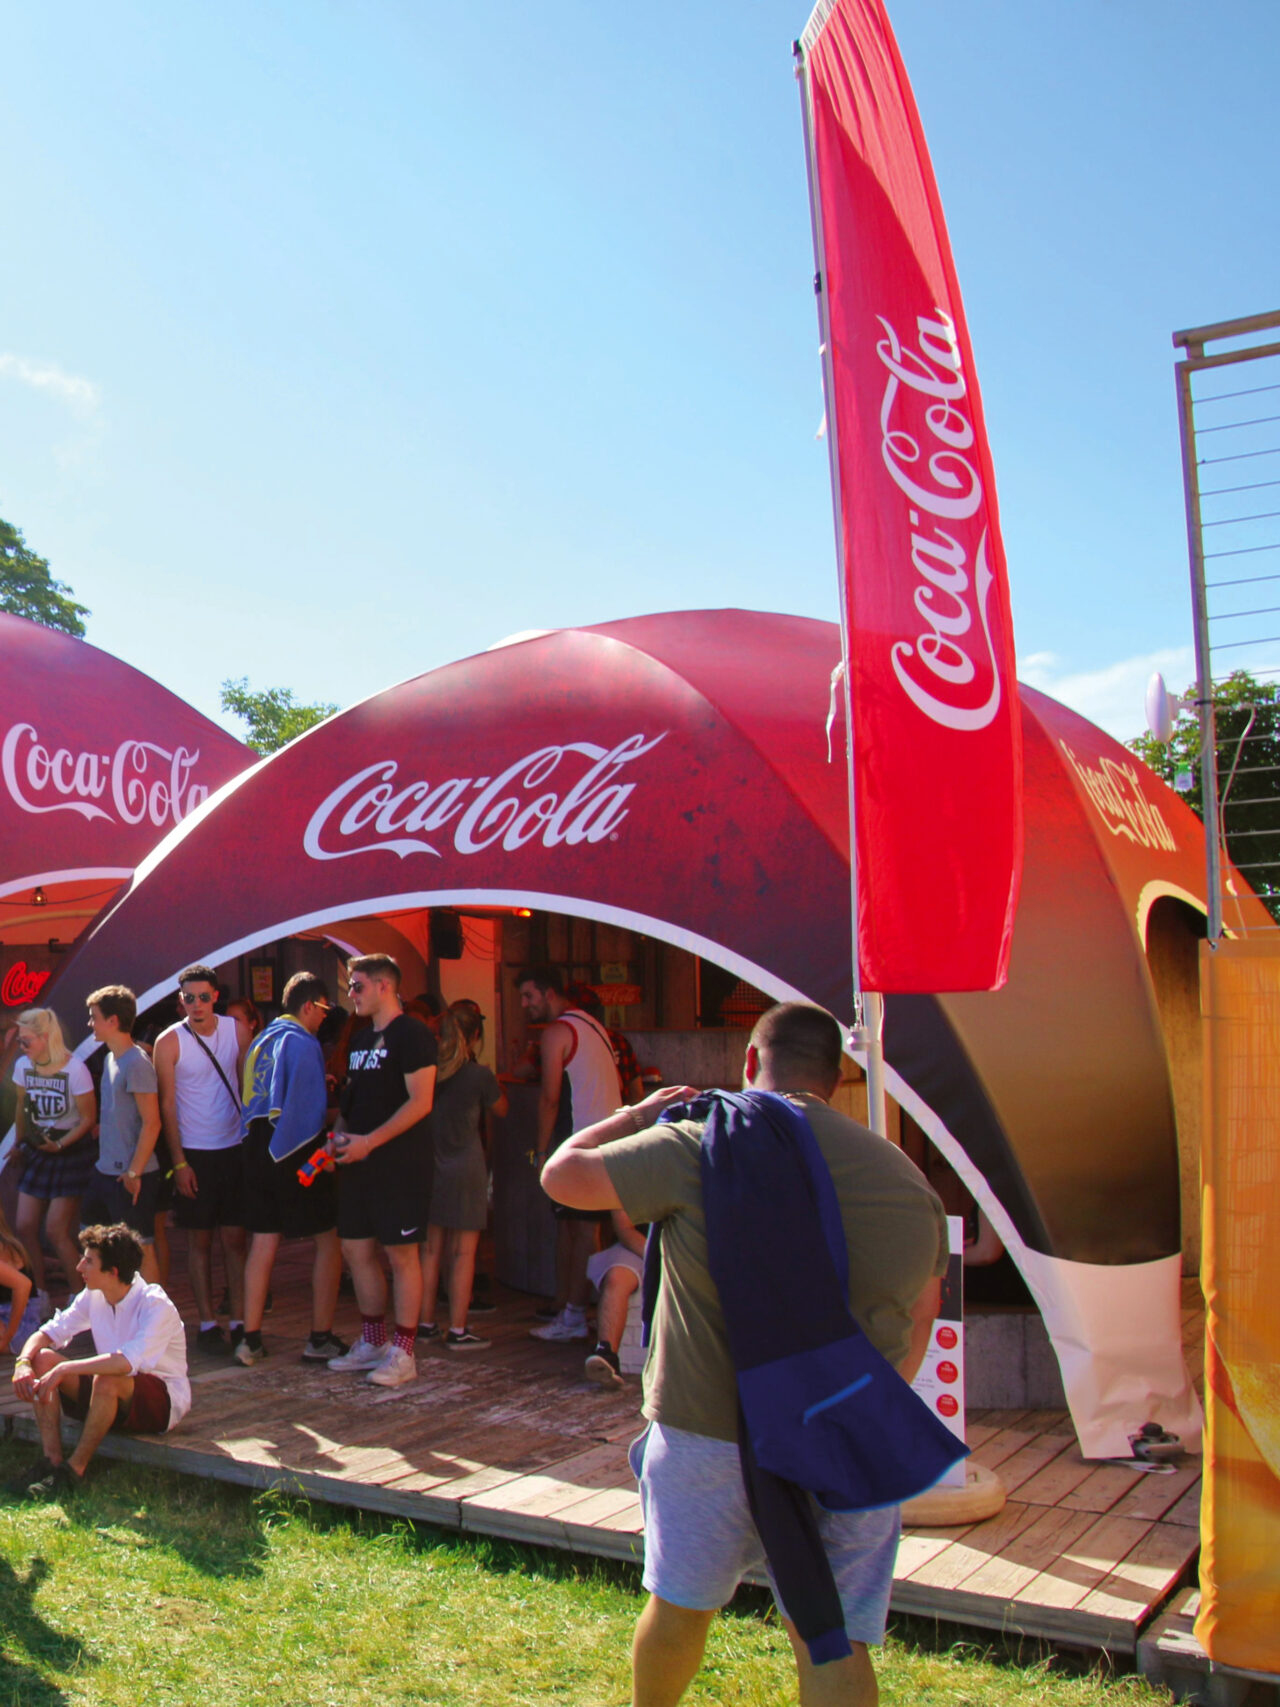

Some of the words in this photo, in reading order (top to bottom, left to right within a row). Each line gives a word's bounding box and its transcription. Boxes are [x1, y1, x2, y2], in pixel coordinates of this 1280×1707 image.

[876, 307, 1001, 731] Coca-Cola
[303, 730, 670, 861] Coca-Cola
[1058, 738, 1177, 852] Coca-Cola
